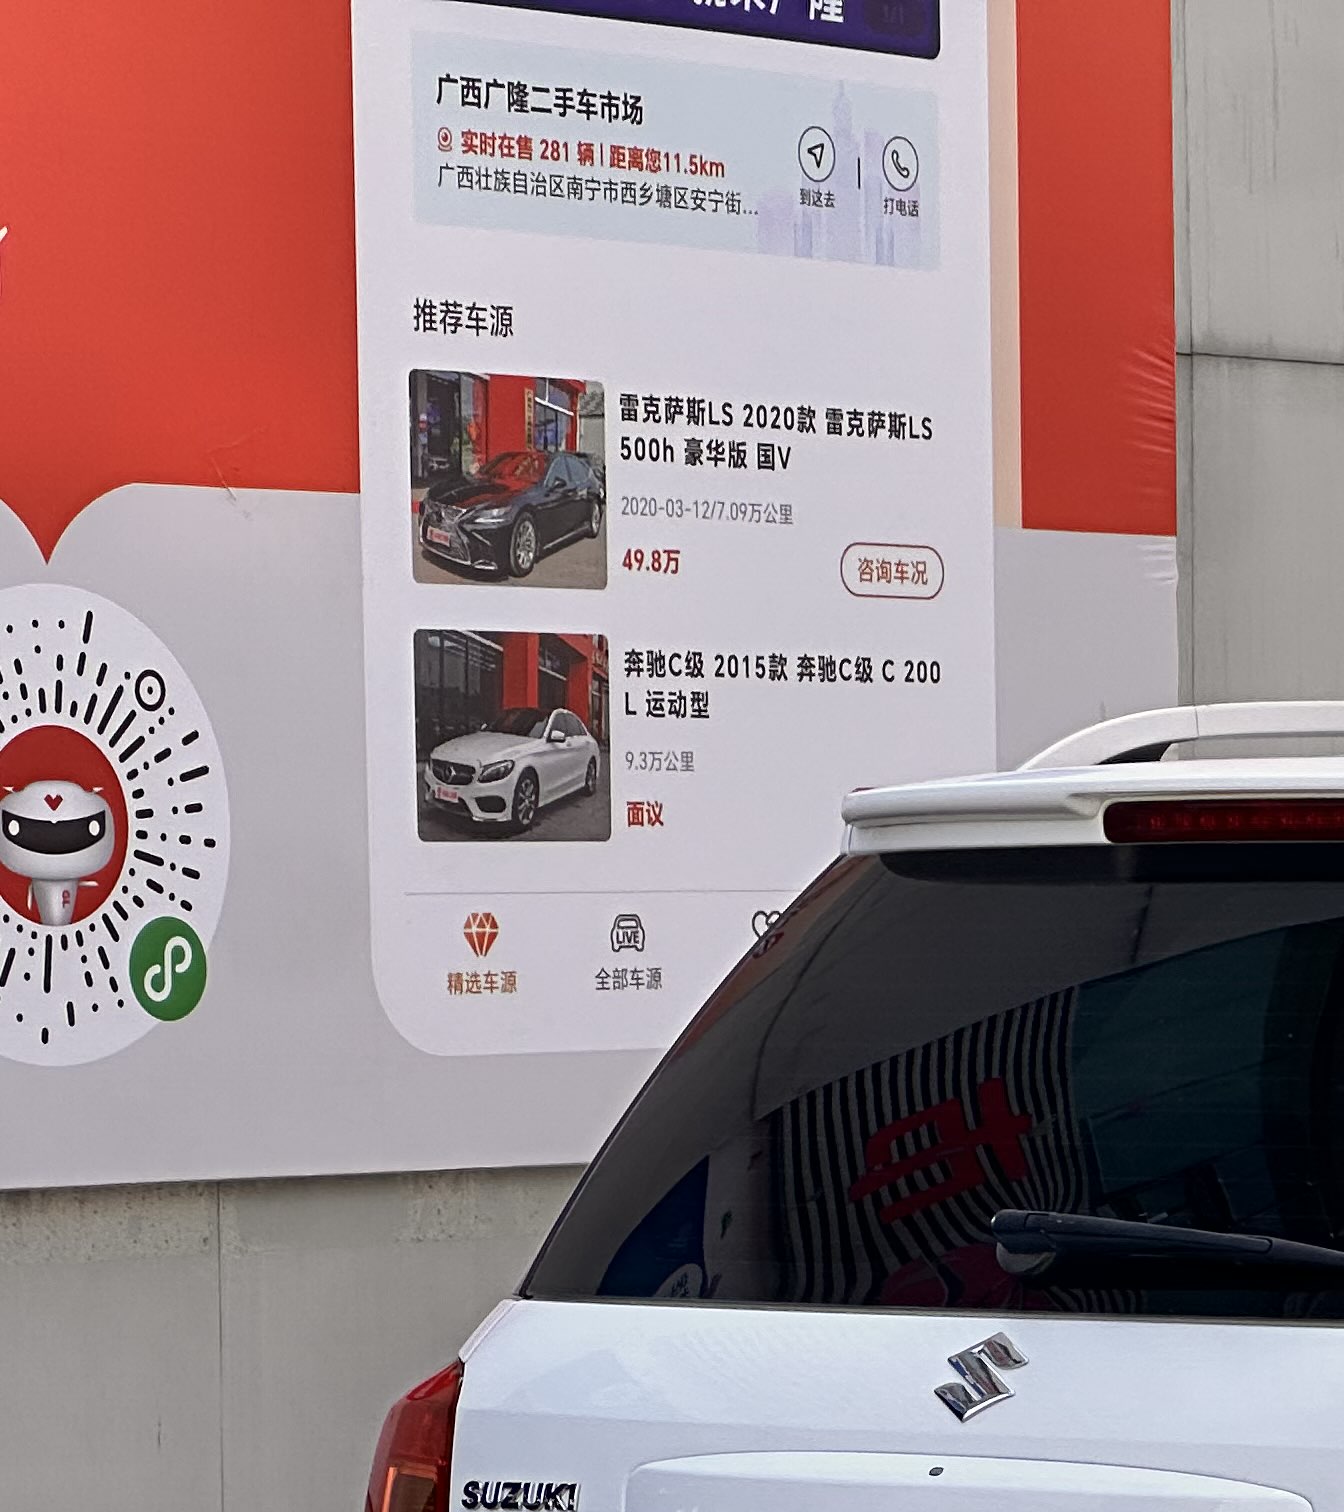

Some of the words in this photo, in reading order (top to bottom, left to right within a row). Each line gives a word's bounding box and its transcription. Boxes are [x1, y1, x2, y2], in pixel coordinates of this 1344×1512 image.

[437, 73, 645, 127] 广西广隆二手车市场
[461, 129, 533, 161] 实时在售
[540, 139, 568, 162] 281
[577, 141, 594, 166] 辆
[609, 145, 724, 180] 距离您11.5km
[800, 188, 835, 208] 到这去
[884, 197, 918, 217] 打电话
[414, 298, 513, 337] 推荐车源
[620, 394, 733, 426] 雷克萨斯LS
[743, 404, 816, 434] 2020款
[826, 408, 932, 440] 雷克萨斯LS
[621, 436, 674, 462] 500h
[684, 438, 747, 469] 豪华版
[757, 443, 791, 471] 国V
[622, 496, 793, 524] 2020-03-12/7.09万公里
[622, 549, 680, 574] 49.8万
[858, 557, 928, 585] 咨询车况
[624, 649, 704, 678] 奔驰C级
[715, 653, 788, 681] 2015款
[797, 656, 873, 683] 奔驰C级
[882, 659, 894, 682] C
[905, 660, 940, 683] 200
[625, 692, 637, 715] L
[646, 690, 709, 718] 运动型
[625, 751, 694, 772] 9.3万公里
[627, 801, 664, 827] 面议
[447, 970, 516, 995] 精选车源
[595, 968, 662, 990] 全部车源
[461, 1480, 580, 1512] SUZUKI
